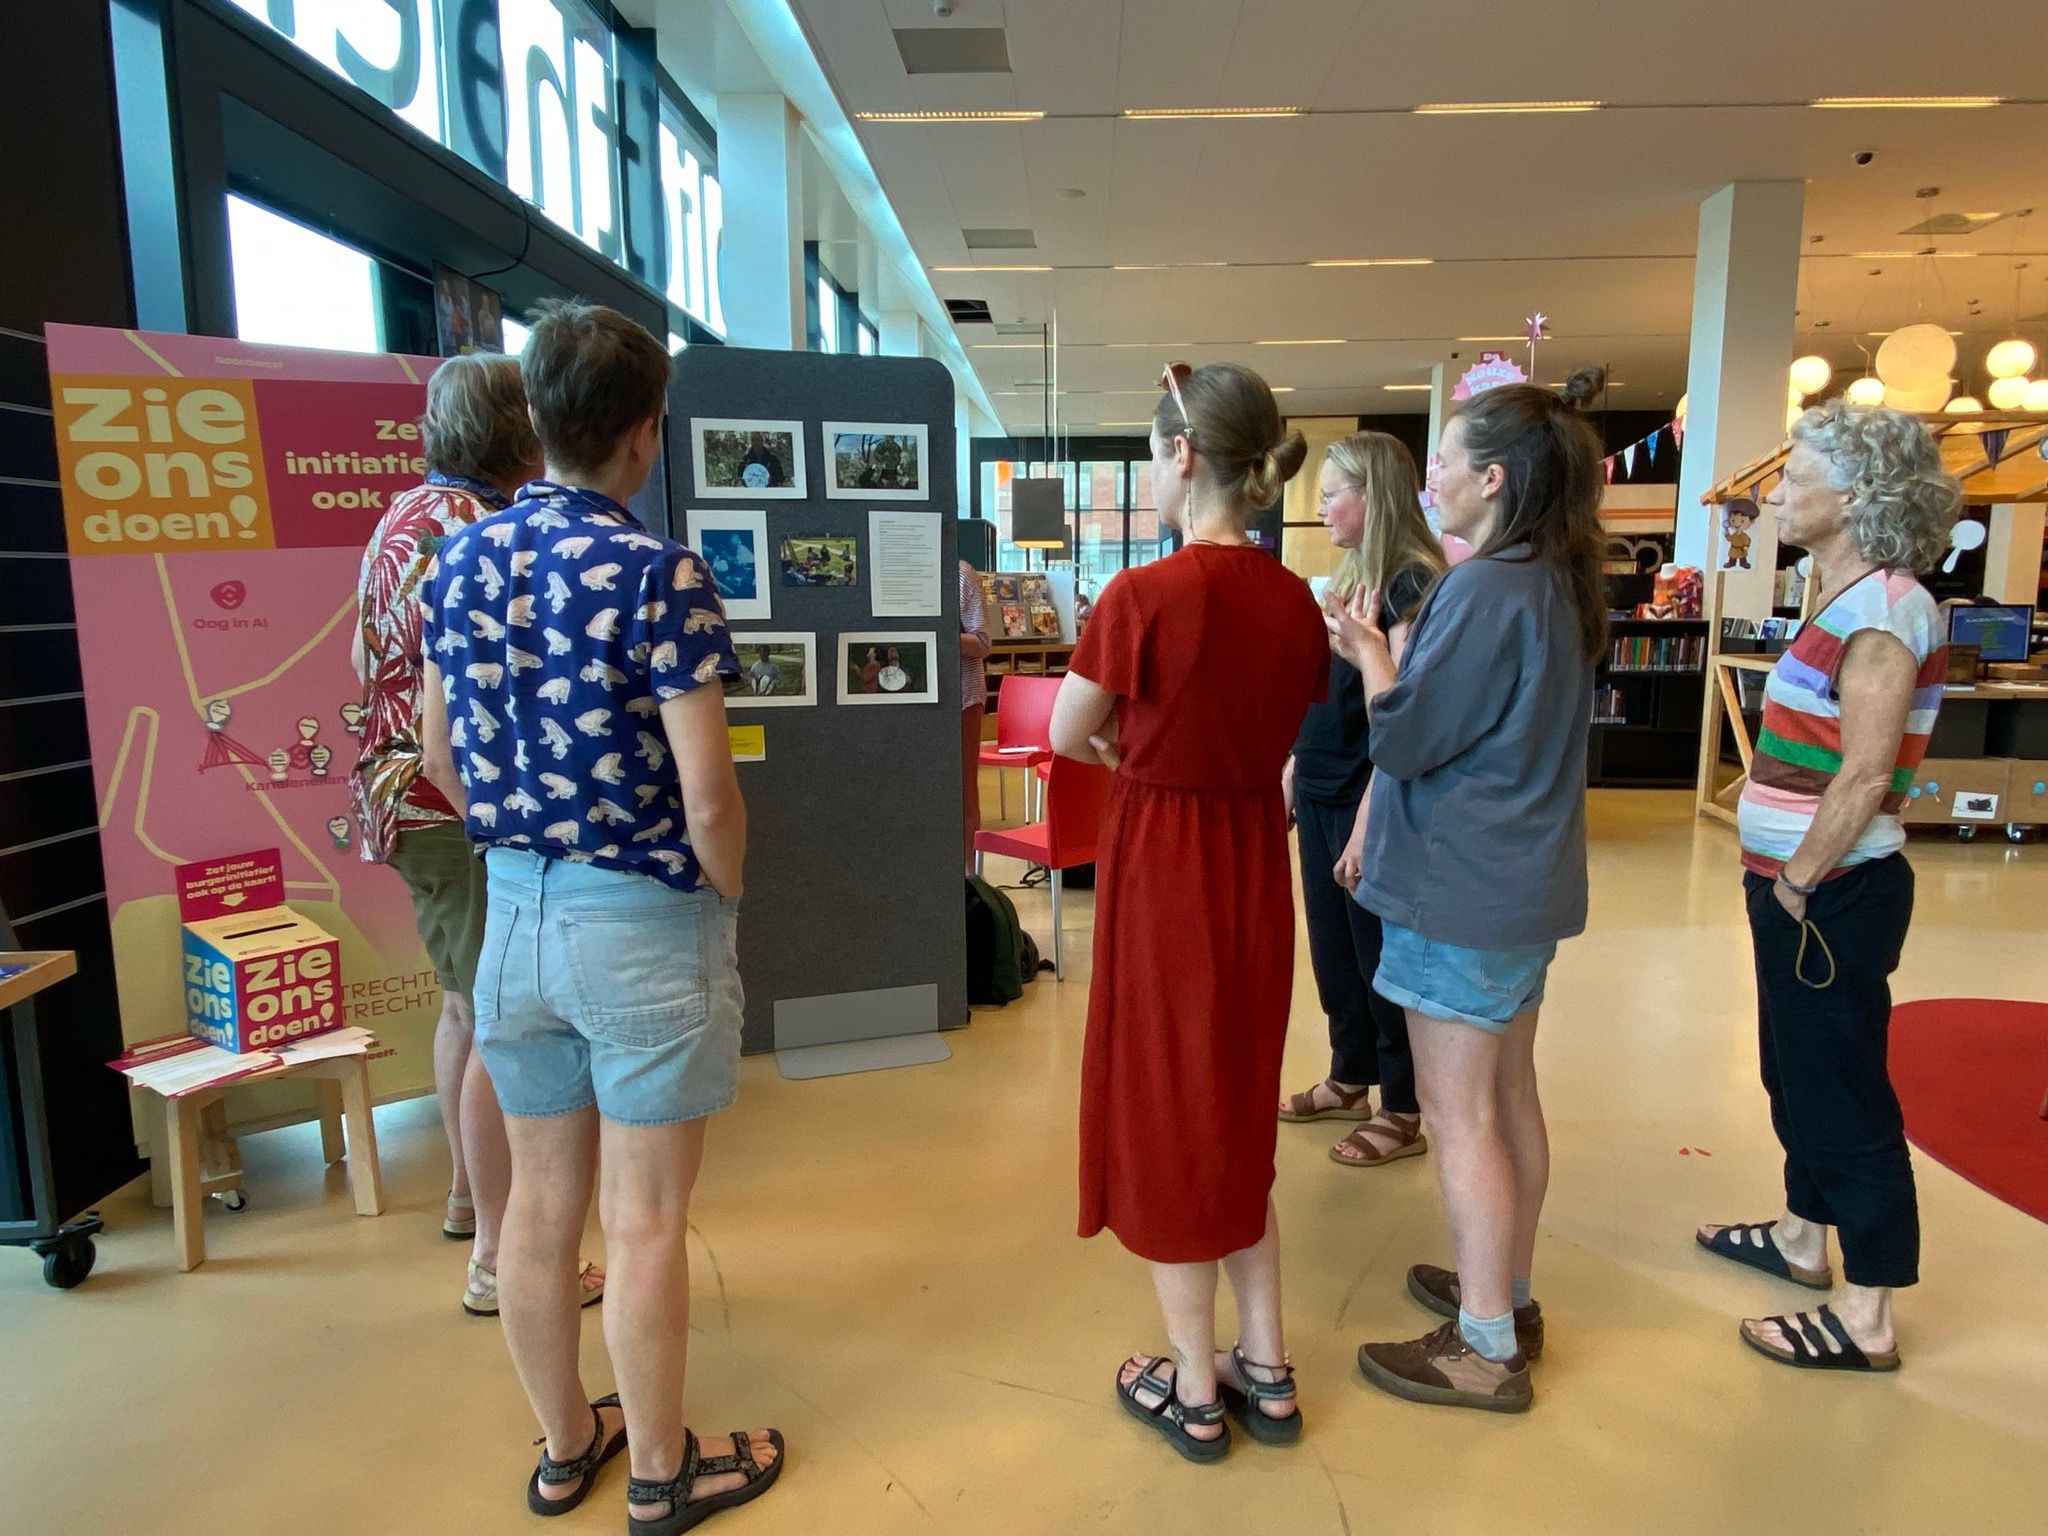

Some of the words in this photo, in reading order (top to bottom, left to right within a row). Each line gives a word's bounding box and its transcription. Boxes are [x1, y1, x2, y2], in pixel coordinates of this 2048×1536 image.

[74, 451, 253, 500] ons
[285, 451, 427, 475] initiatie
[311, 488, 384, 510] ook
[83, 494, 257, 543] doen!
[193, 619, 229, 631] Oog
[232, 617, 249, 628] in
[186, 865, 275, 889] burgerinitiatief
[226, 860, 254, 872] jouw
[186, 889, 209, 899] ook
[210, 886, 226, 894] op
[227, 882, 242, 891] de
[246, 979, 334, 1022] ons
[341, 970, 441, 1001] TRECHTE
[188, 988, 233, 1020] ons
[342, 990, 437, 1021] TRECHT
[190, 1018, 234, 1047] doen!
[249, 1002, 335, 1046] doen!
